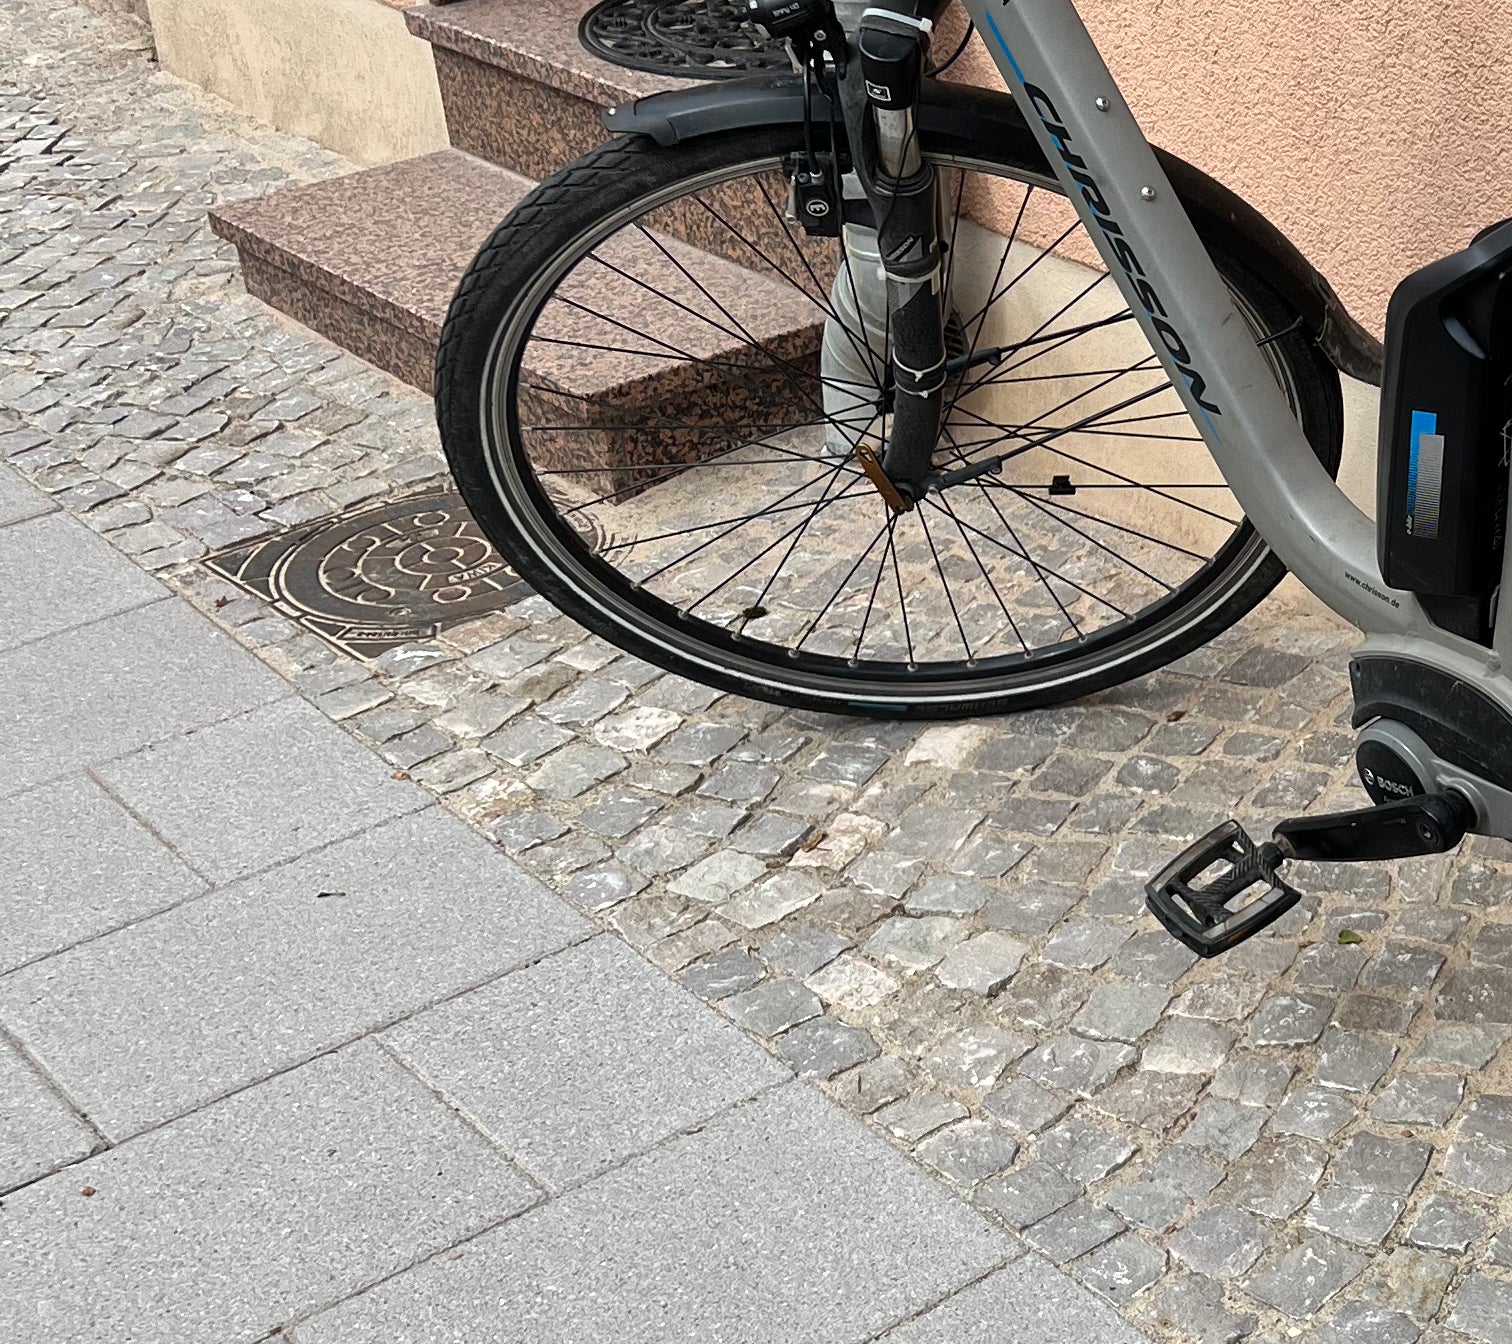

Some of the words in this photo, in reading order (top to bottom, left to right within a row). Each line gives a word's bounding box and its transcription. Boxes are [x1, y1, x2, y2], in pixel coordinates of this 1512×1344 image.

[1023, 82, 1222, 416] CHRISSON
[1344, 571, 1400, 609] www.chrisson.de
[1376, 775, 1415, 797] BOSCH
